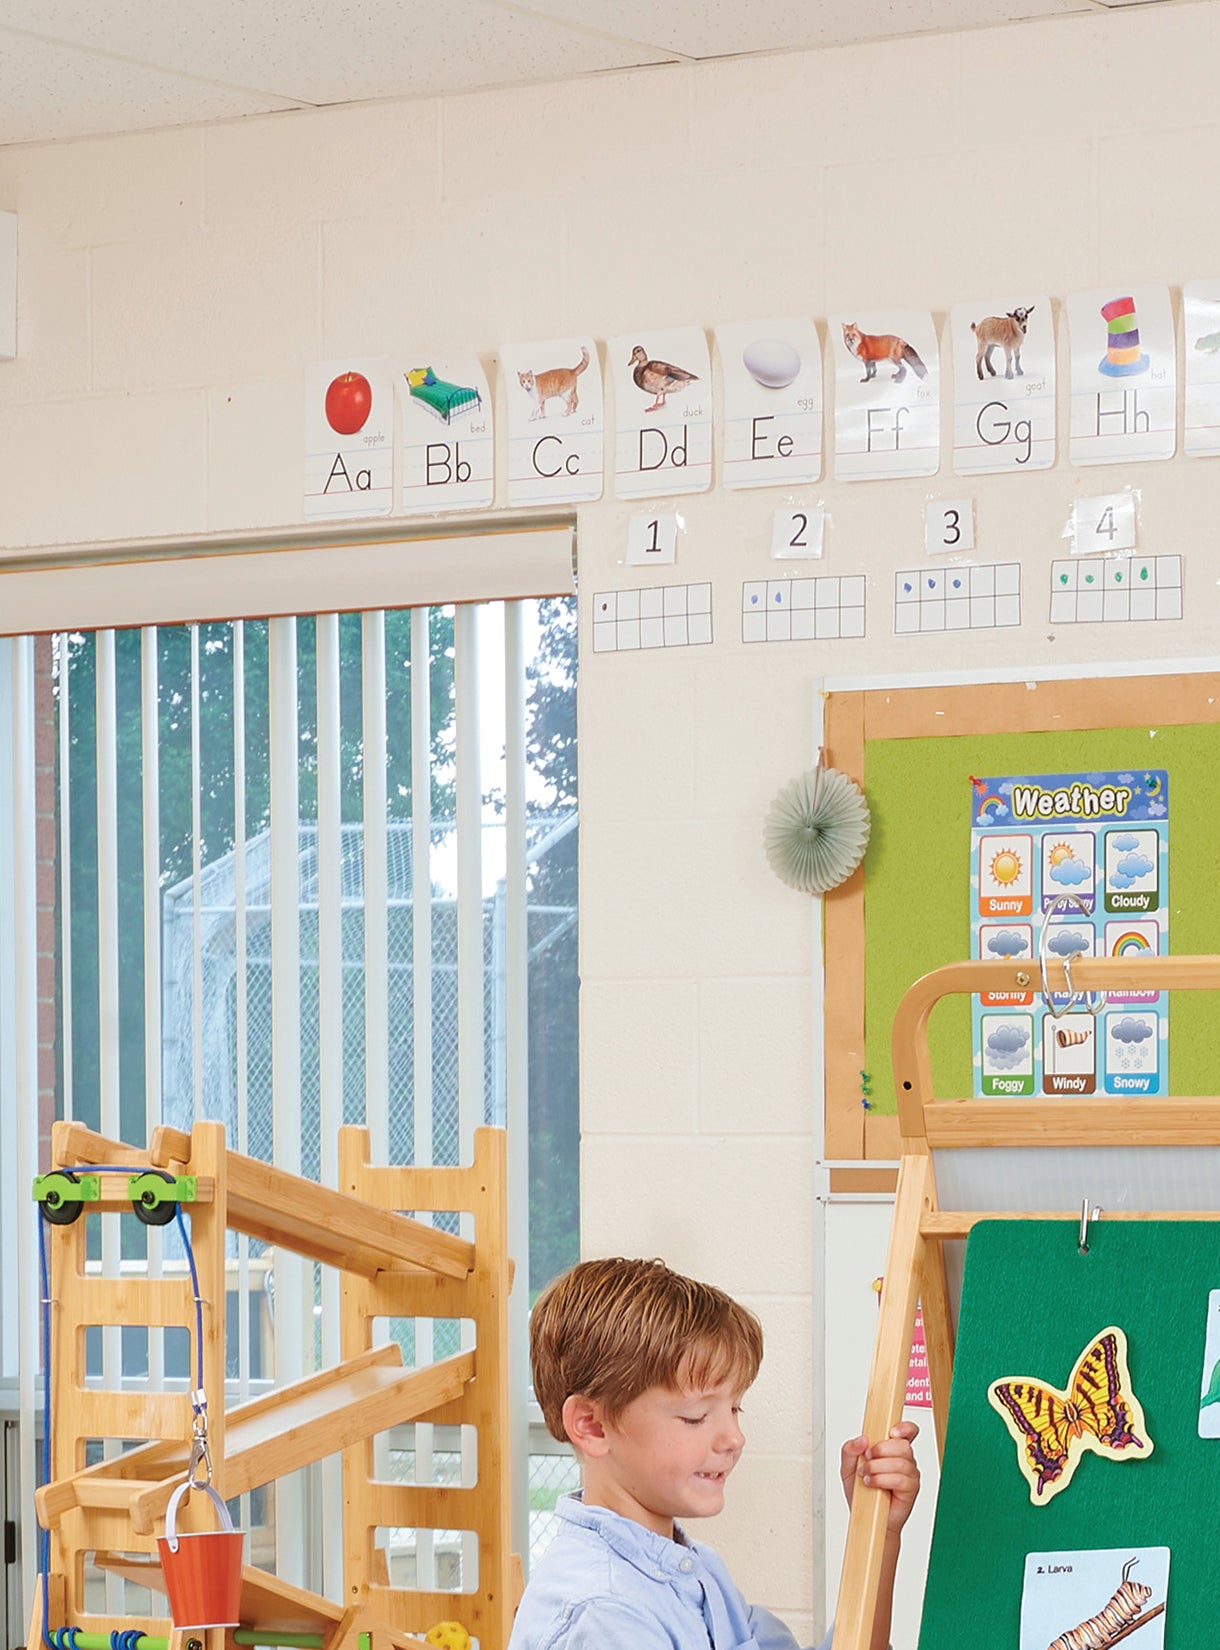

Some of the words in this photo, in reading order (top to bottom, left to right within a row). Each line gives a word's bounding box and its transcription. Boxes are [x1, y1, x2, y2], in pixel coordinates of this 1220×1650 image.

[1151, 368, 1168, 381] hat
[915, 386, 931, 398] fox
[1025, 380, 1047, 395] goat
[682, 405, 705, 418] duck
[797, 396, 815, 411] egg
[1096, 388, 1151, 436] Hh
[469, 420, 487, 434] bed
[580, 414, 596, 427] cat
[867, 405, 911, 452] Ff
[362, 431, 386, 447] apple
[750, 415, 795, 461] Ee
[975, 400, 1033, 465] Gg
[637, 424, 690, 472] Dd
[425, 442, 473, 485] Bb
[531, 435, 581, 478] Cc
[322, 452, 373, 494] Aa
[788, 513, 808, 548] 2
[942, 509, 961, 544] 3
[1094, 505, 1118, 541] 4
[645, 520, 663, 553] 1
[1013, 784, 1129, 817] Weather
[989, 898, 1023, 913] Sunny
[1111, 894, 1150, 909] Cloudy
[991, 1077, 1025, 1092] Foggy
[1052, 1077, 1087, 1091] Windy
[1113, 1076, 1151, 1091] Snowy
[1037, 1566, 1045, 1574] 2.
[1048, 1564, 1073, 1574] Larva
